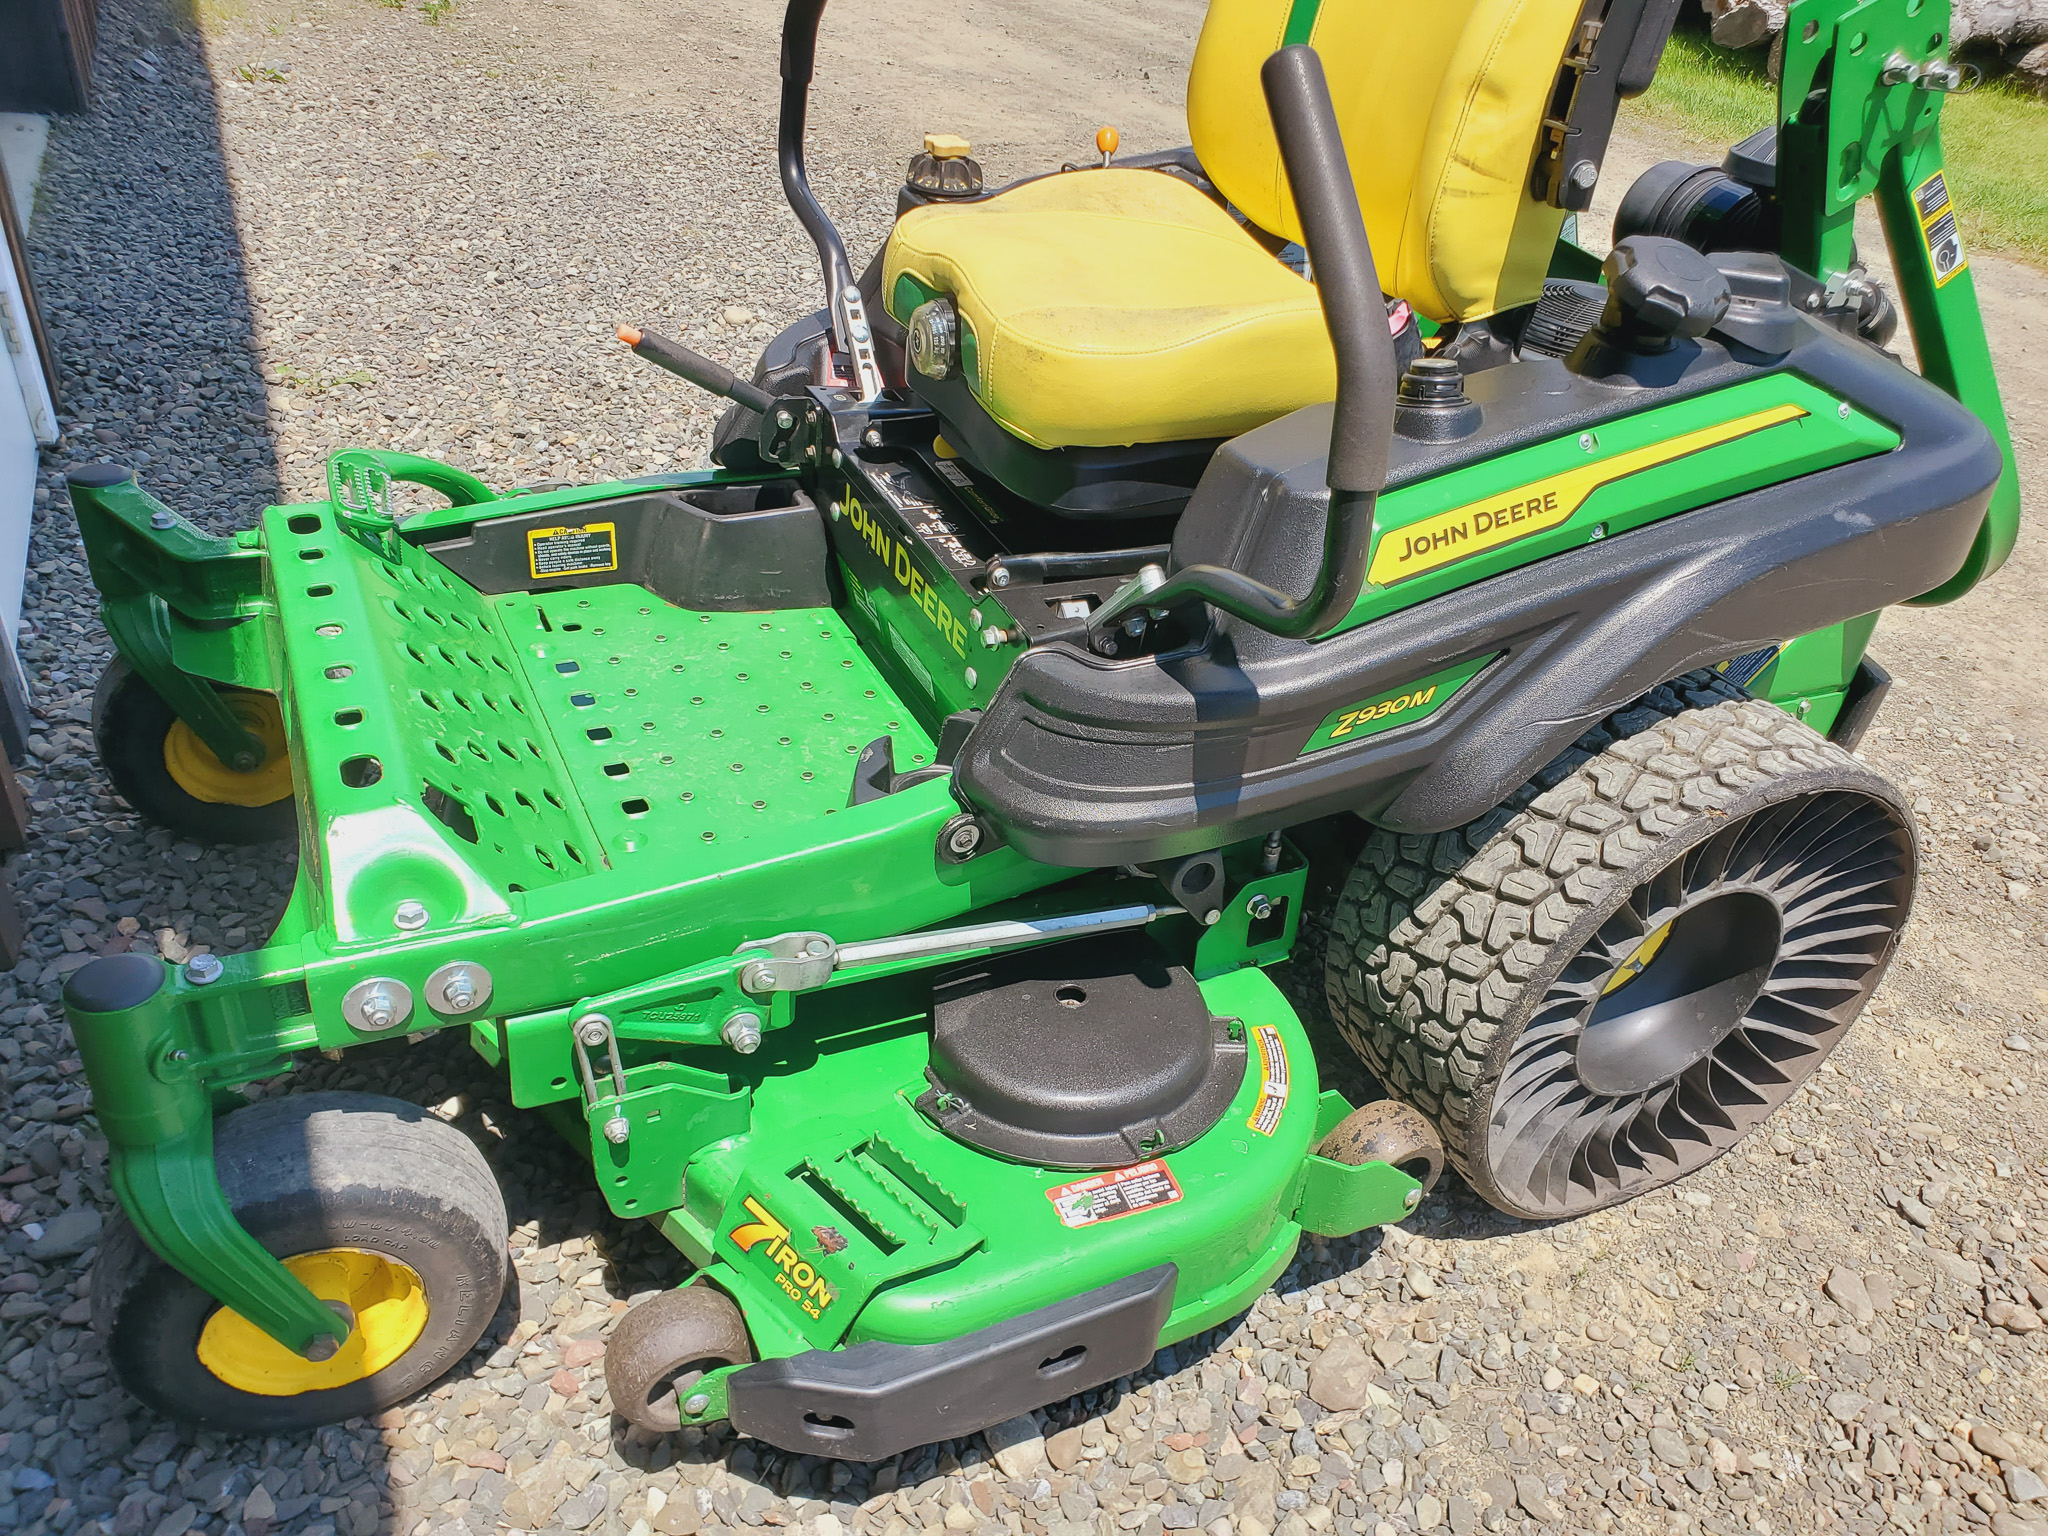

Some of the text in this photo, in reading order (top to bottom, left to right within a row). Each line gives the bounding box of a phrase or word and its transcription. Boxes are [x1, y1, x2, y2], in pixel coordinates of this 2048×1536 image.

[1399, 491, 1558, 562] JOHN DEERE
[839, 483, 890, 567] JOHN
[894, 541, 968, 660] DEERE
[1329, 684, 1438, 739] Z930M
[1070, 1177, 1104, 1192] DANGER
[1123, 1163, 1158, 1178] PELIGRO
[774, 1272, 822, 1320] PRO 54
